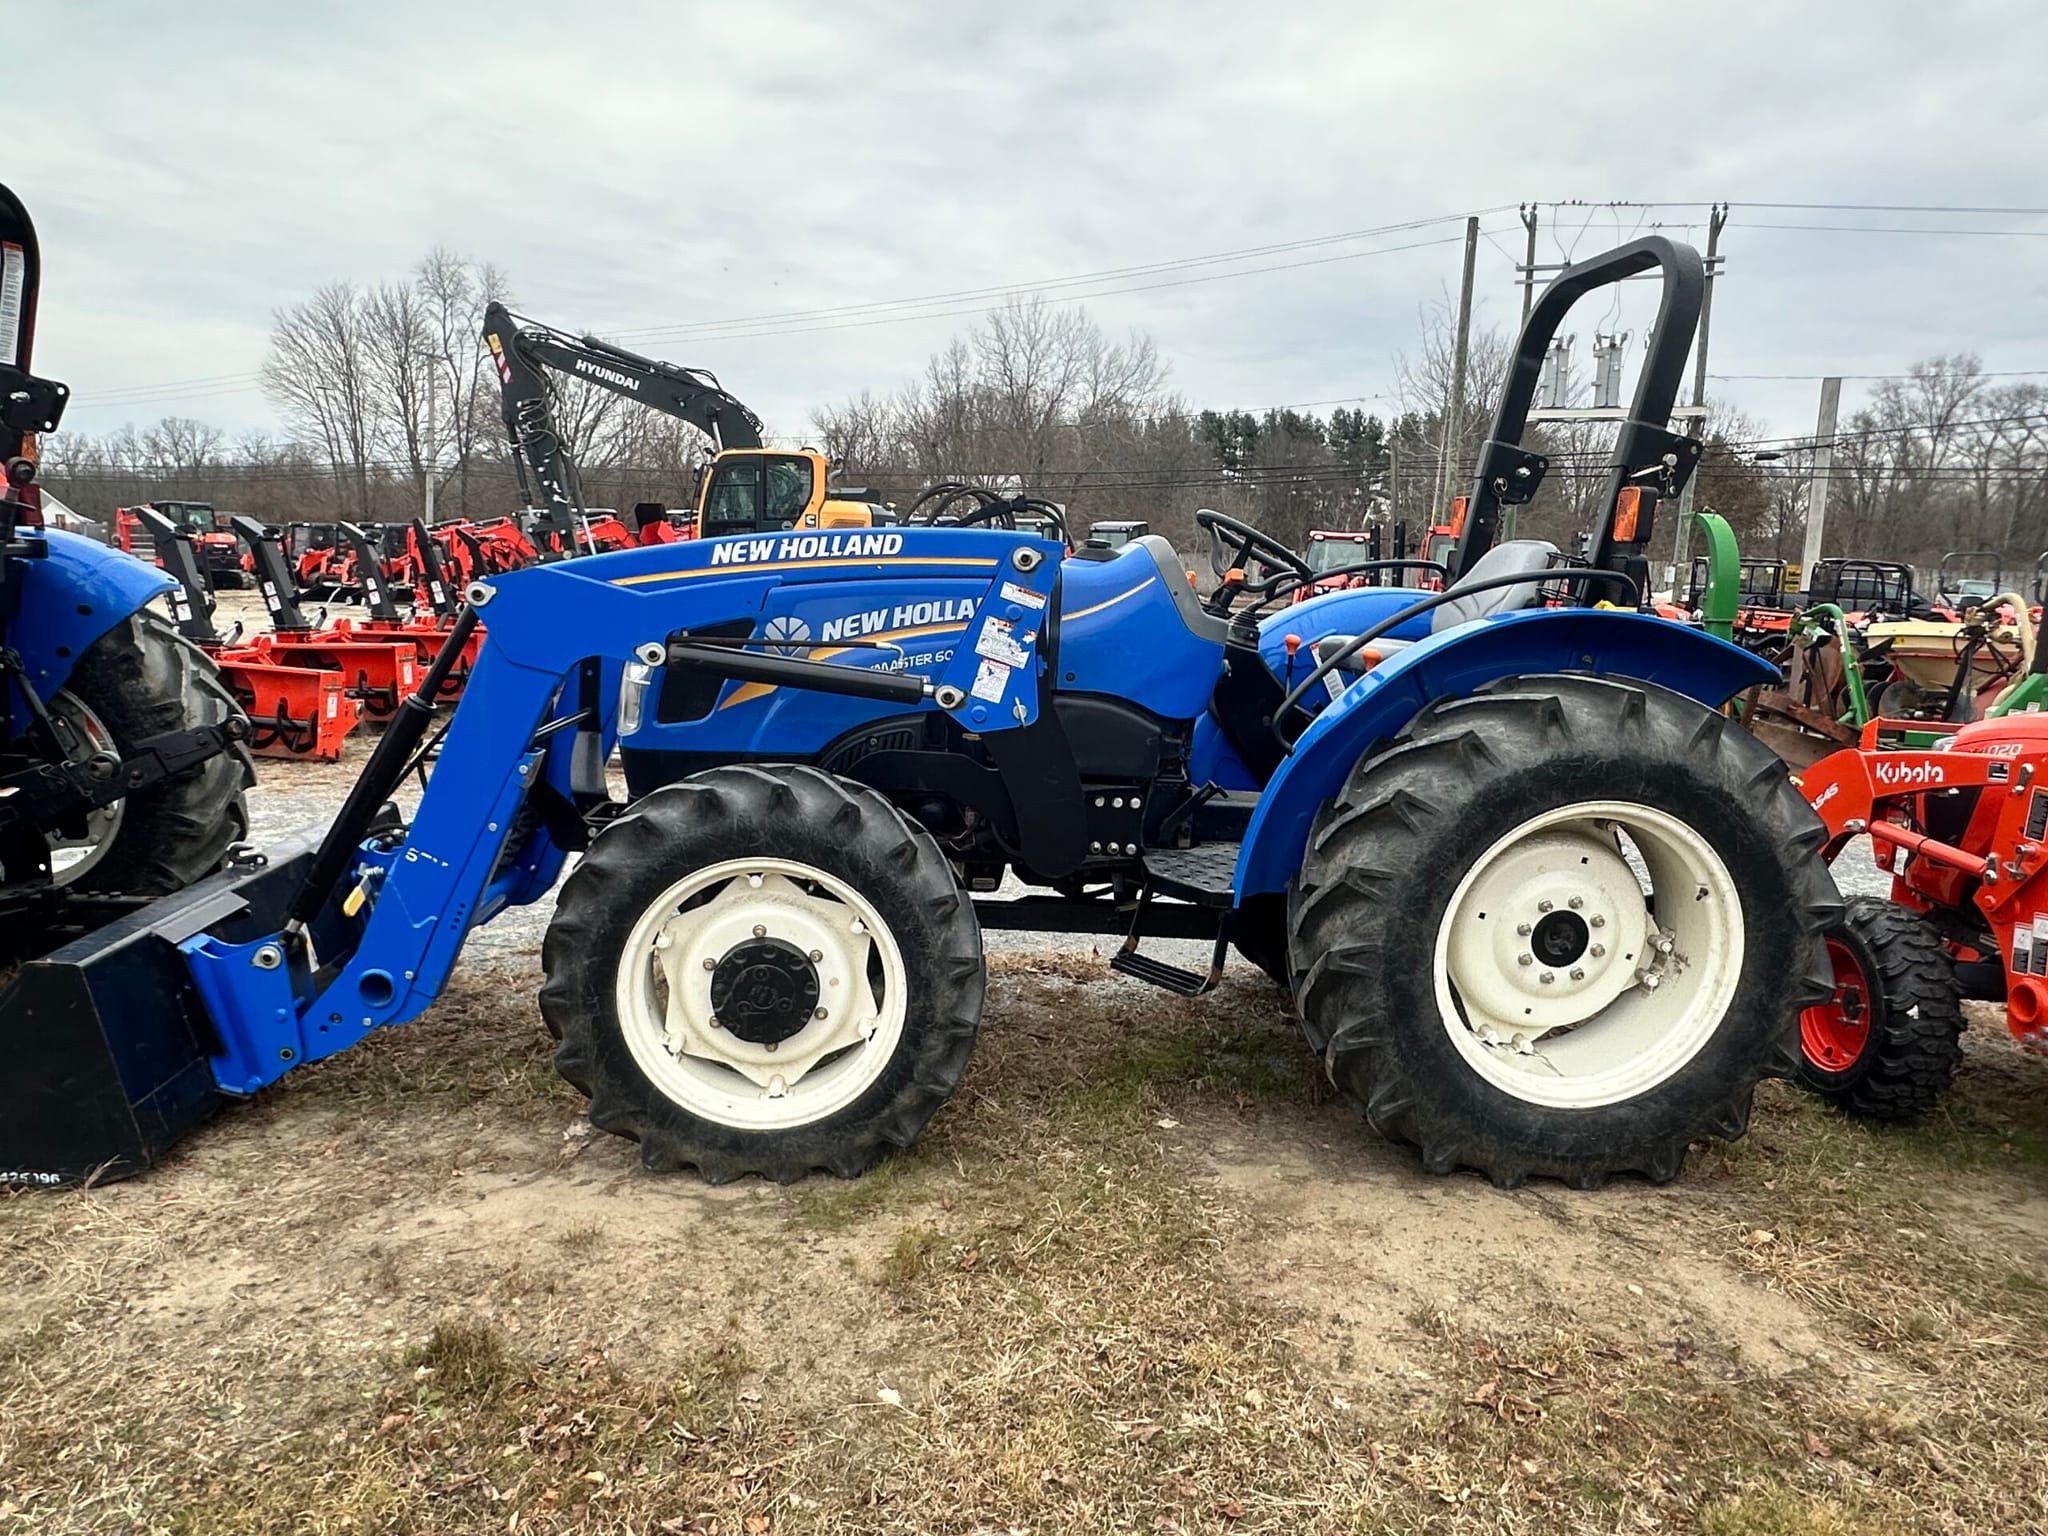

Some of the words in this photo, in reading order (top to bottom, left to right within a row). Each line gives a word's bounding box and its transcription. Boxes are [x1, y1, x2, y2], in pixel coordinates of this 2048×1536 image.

[575, 358, 641, 391] HYUNDAI
[711, 538, 776, 566] NEW
[778, 533, 904, 561] HOLLAND
[821, 608, 889, 642] NEW
[892, 597, 981, 628] HOLLA
[1875, 760, 1944, 784] Kubota
